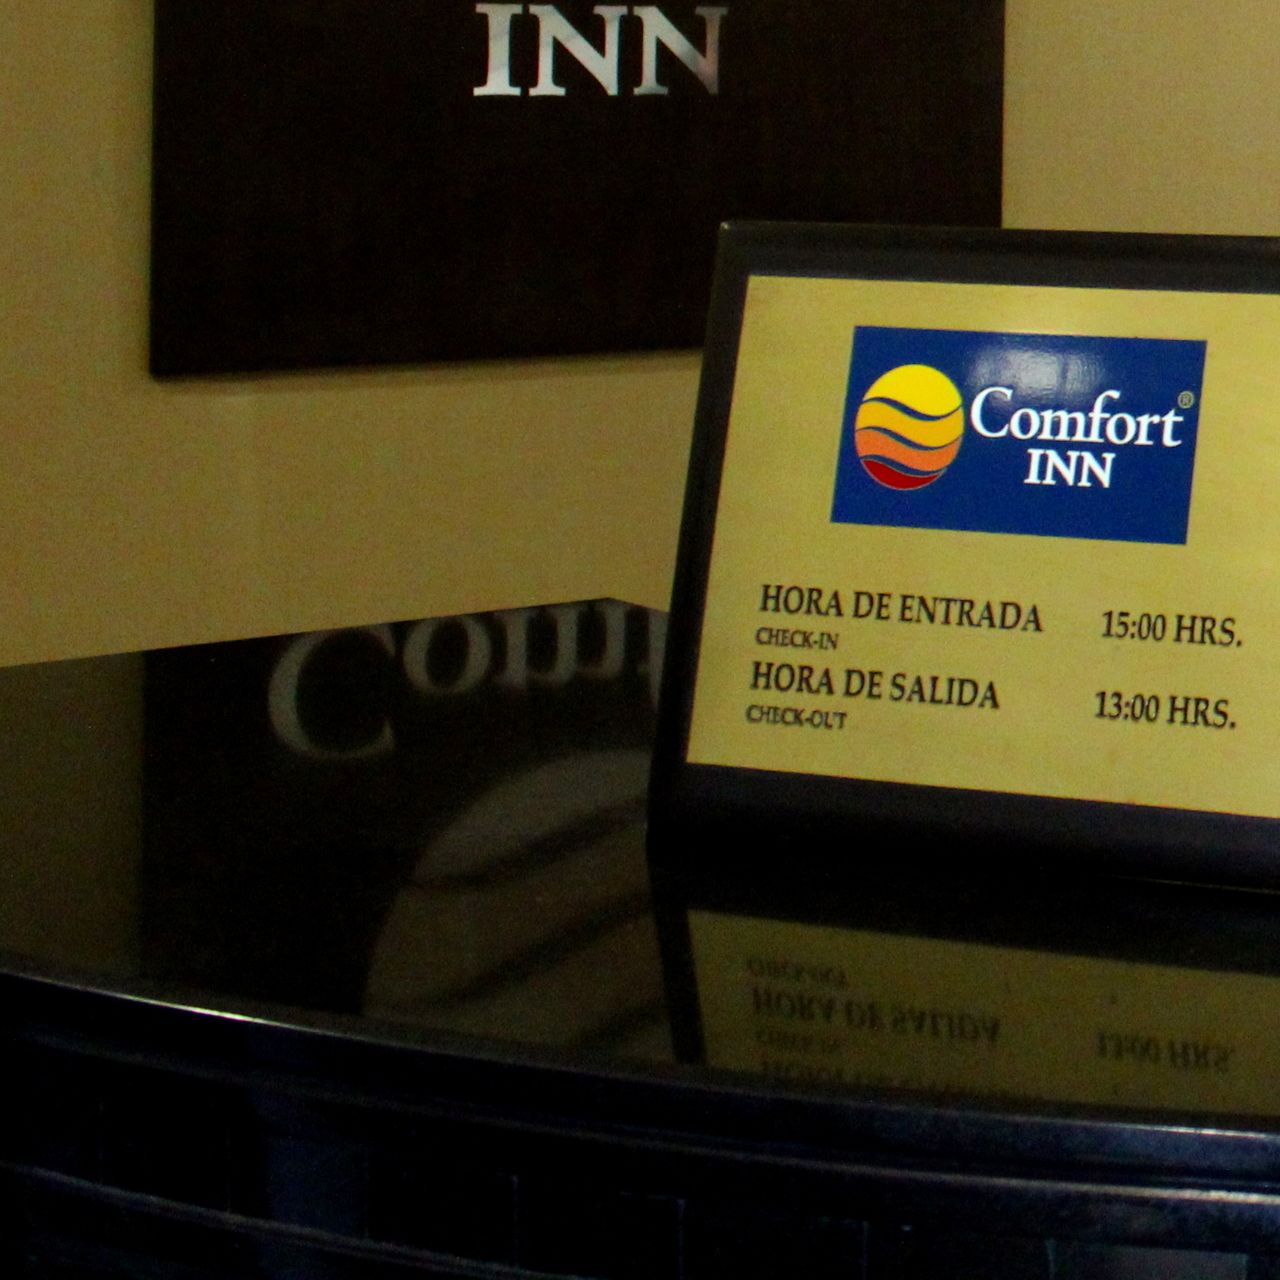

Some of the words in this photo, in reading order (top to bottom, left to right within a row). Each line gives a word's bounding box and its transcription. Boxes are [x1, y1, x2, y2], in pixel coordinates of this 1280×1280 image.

[472, 3, 729, 98] INN
[969, 385, 1185, 448] Comfort
[1023, 447, 1116, 489] INN
[755, 625, 840, 651] CHECK-IN
[759, 583, 845, 617] HORA
[852, 590, 892, 621] DE
[899, 594, 1044, 633] ENTRADA
[1101, 610, 1168, 643] 15:00
[1172, 615, 1244, 649] HRS.
[745, 703, 848, 731] CHECK-OUT
[750, 660, 835, 695] HORA
[843, 667, 883, 700] DE
[888, 672, 1000, 710] SALIDA
[1094, 690, 1161, 723] 13:00
[1166, 696, 1237, 730] HRS.
